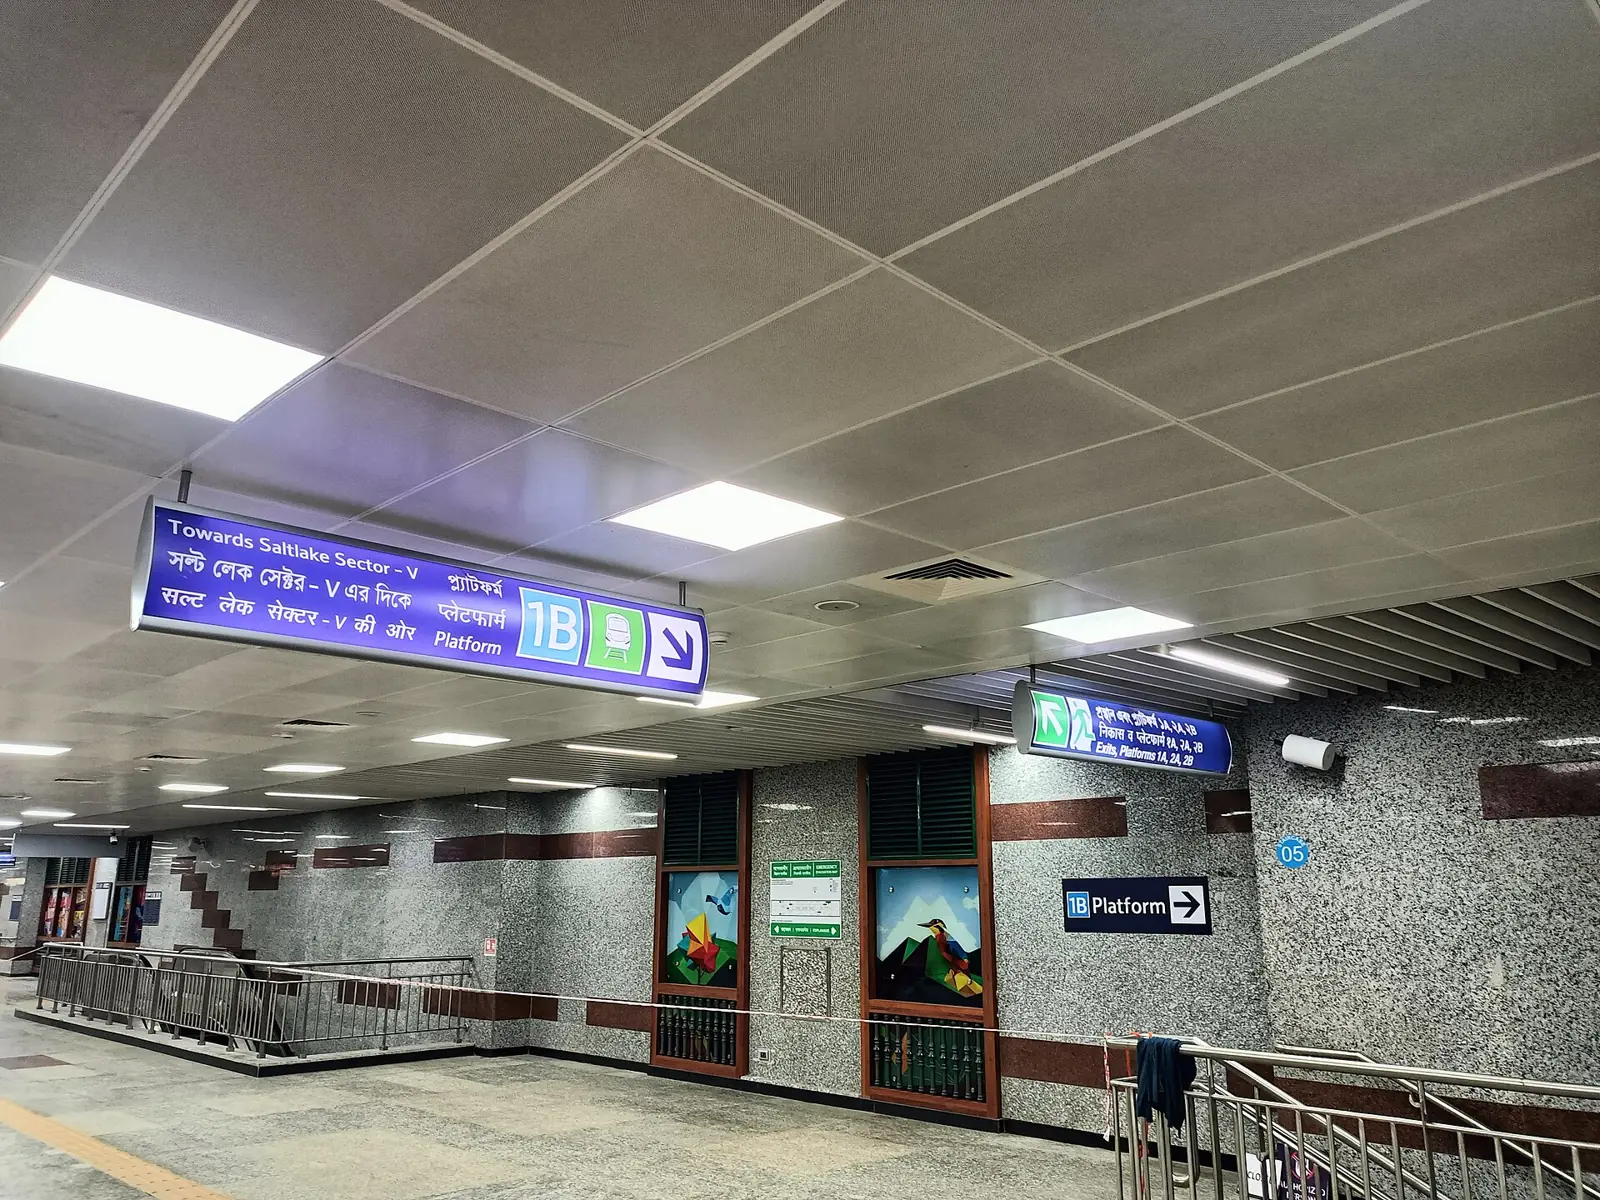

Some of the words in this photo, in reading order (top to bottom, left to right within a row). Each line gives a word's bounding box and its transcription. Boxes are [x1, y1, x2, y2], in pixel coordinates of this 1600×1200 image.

[168, 519, 254, 549] Towards
[260, 537, 330, 563] Saltlake
[335, 552, 390, 574] Sector
[406, 565, 419, 579] V
[167, 547, 206, 573] সল্ট
[213, 560, 254, 582] লেক
[260, 565, 306, 592] সেক্টর
[325, 579, 340, 598] V
[345, 584, 370, 603] এর
[375, 582, 412, 610] দিকে
[161, 587, 206, 608] सल्ट
[219, 592, 255, 615] लेक
[267, 599, 319, 626] सेक्टर
[335, 614, 347, 630] V
[354, 614, 376, 635] की
[386, 619, 417, 640] ओर
[437, 600, 507, 630] प्लेटफार्म
[527, 601, 578, 651] 1B
[434, 630, 502, 656] Platform
[1099, 720, 1125, 740] निकास
[1127, 729, 1134, 743] व
[1135, 727, 1165, 747] प्लेटफार्म
[1096, 741, 1118, 758] Exits,
[1119, 744, 1156, 761] Platforms
[1156, 750, 1169, 765] 1A,
[1169, 752, 1182, 767] 2A,
[1182, 754, 1194, 767] 2B
[1281, 845, 1304, 862] 05
[1069, 897, 1088, 914] 1B
[1092, 896, 1166, 915] Platform
